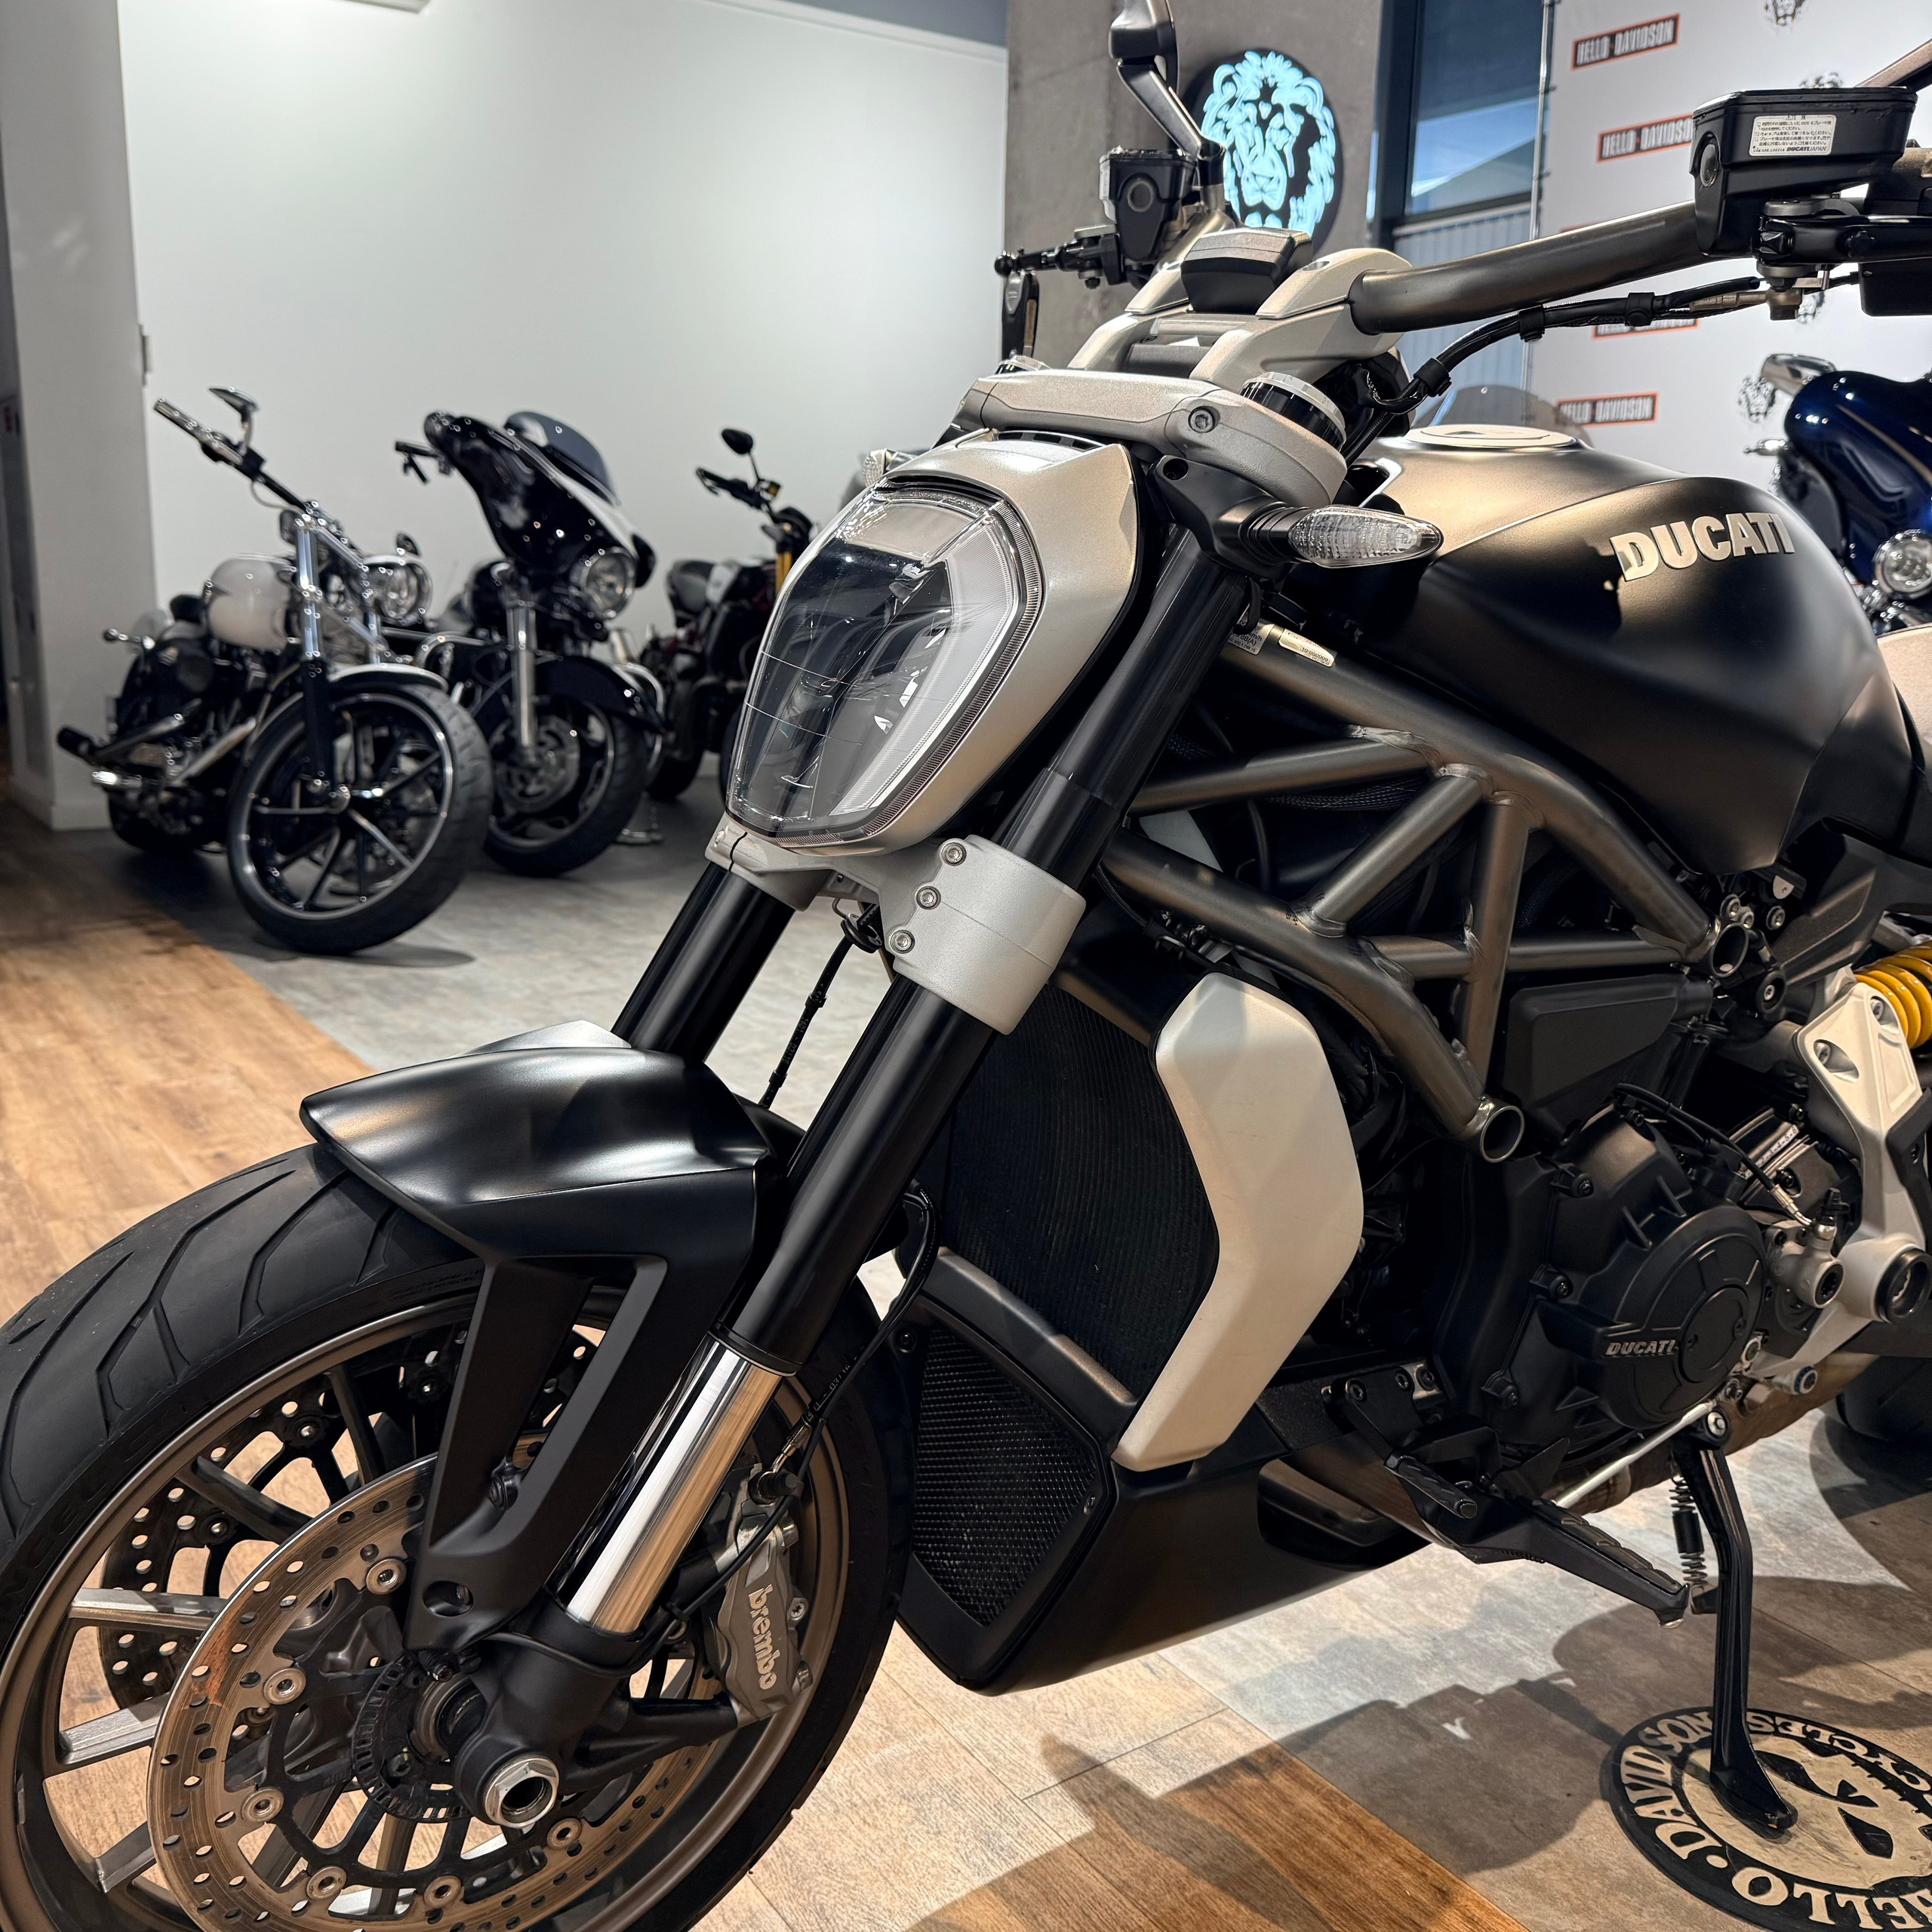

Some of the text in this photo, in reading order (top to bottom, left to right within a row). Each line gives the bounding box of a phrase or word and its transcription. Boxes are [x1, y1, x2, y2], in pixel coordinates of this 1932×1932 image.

[1577, 18, 1675, 66] HELLO DAVIDSON
[1601, 118, 1693, 158] HELLO DAVIDSO
[1610, 512, 1795, 582] DUCATI
[1605, 1340, 1676, 1355] DUCATI
[748, 1584, 781, 1690] brembo
[1746, 1711, 1932, 1807] CYCLES
